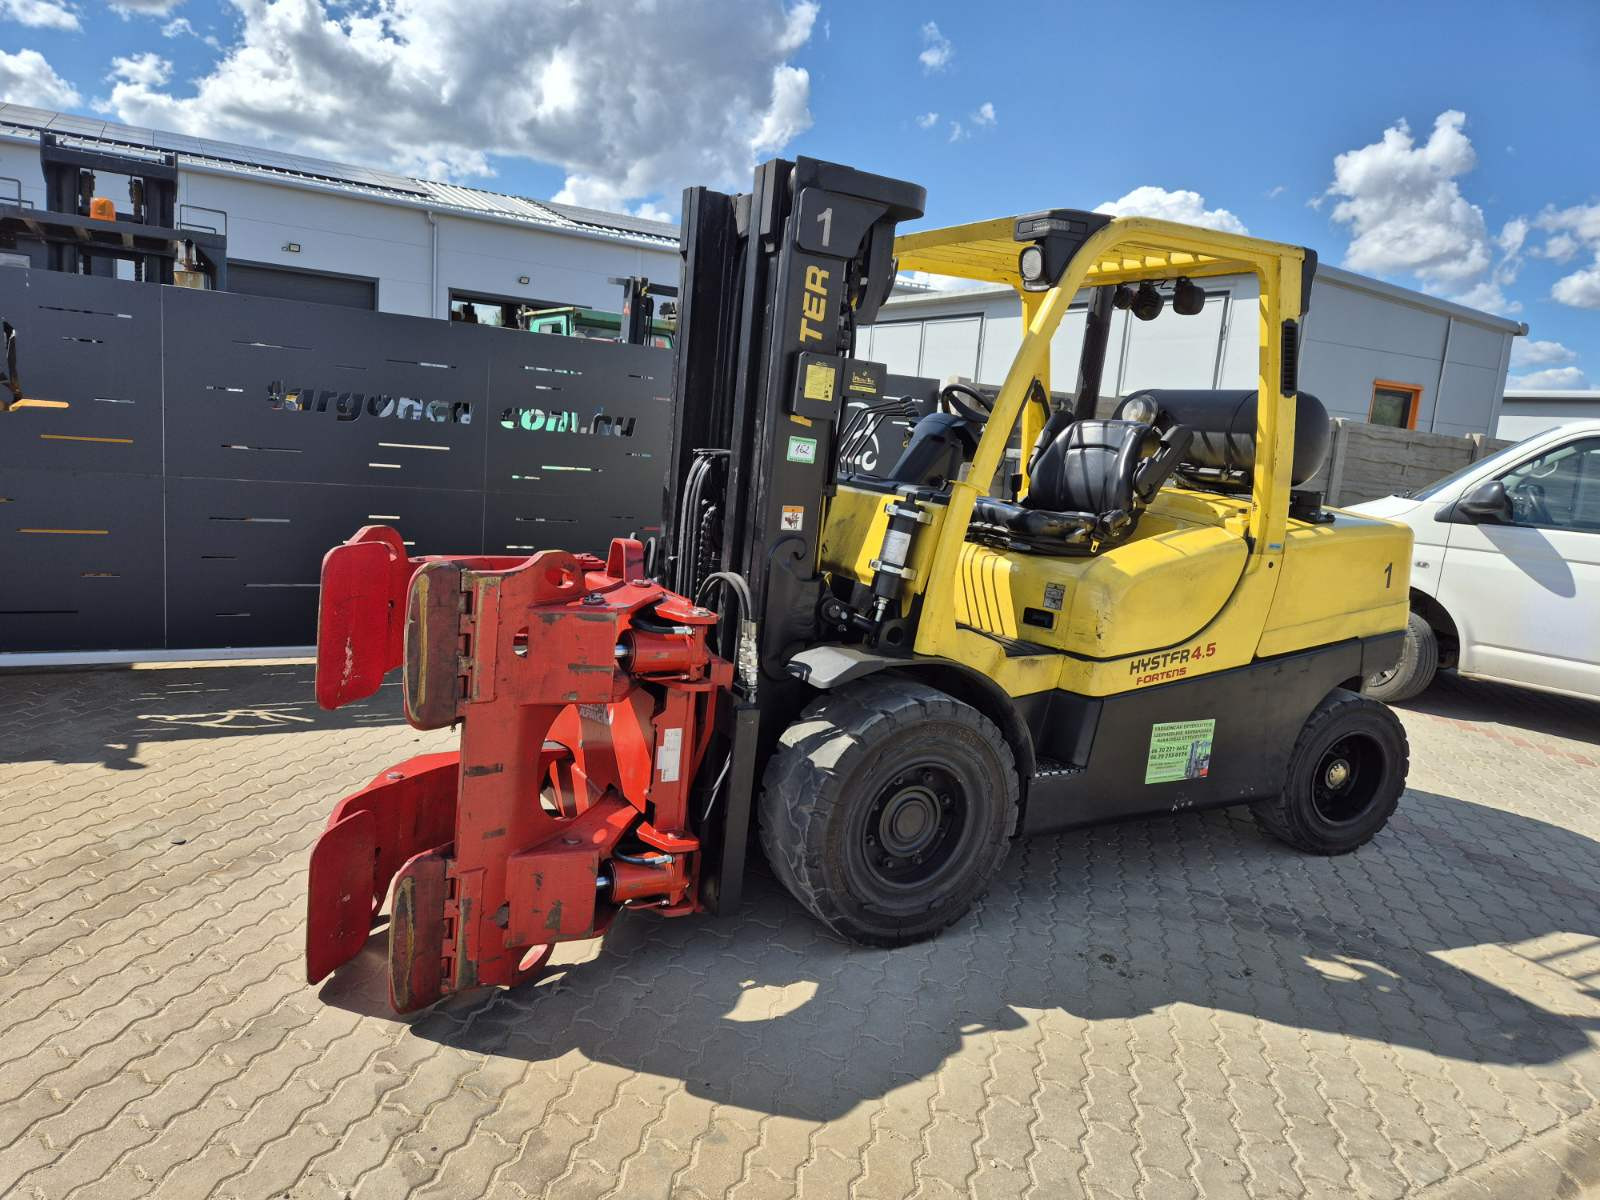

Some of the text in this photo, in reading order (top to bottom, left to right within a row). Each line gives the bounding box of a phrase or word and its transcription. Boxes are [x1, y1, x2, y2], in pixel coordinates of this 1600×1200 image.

[817, 207, 833, 247] 1
[1384, 562, 1393, 588] 1
[1191, 642, 1217, 660] 4.5
[1136, 667, 1188, 685] FORTENS
